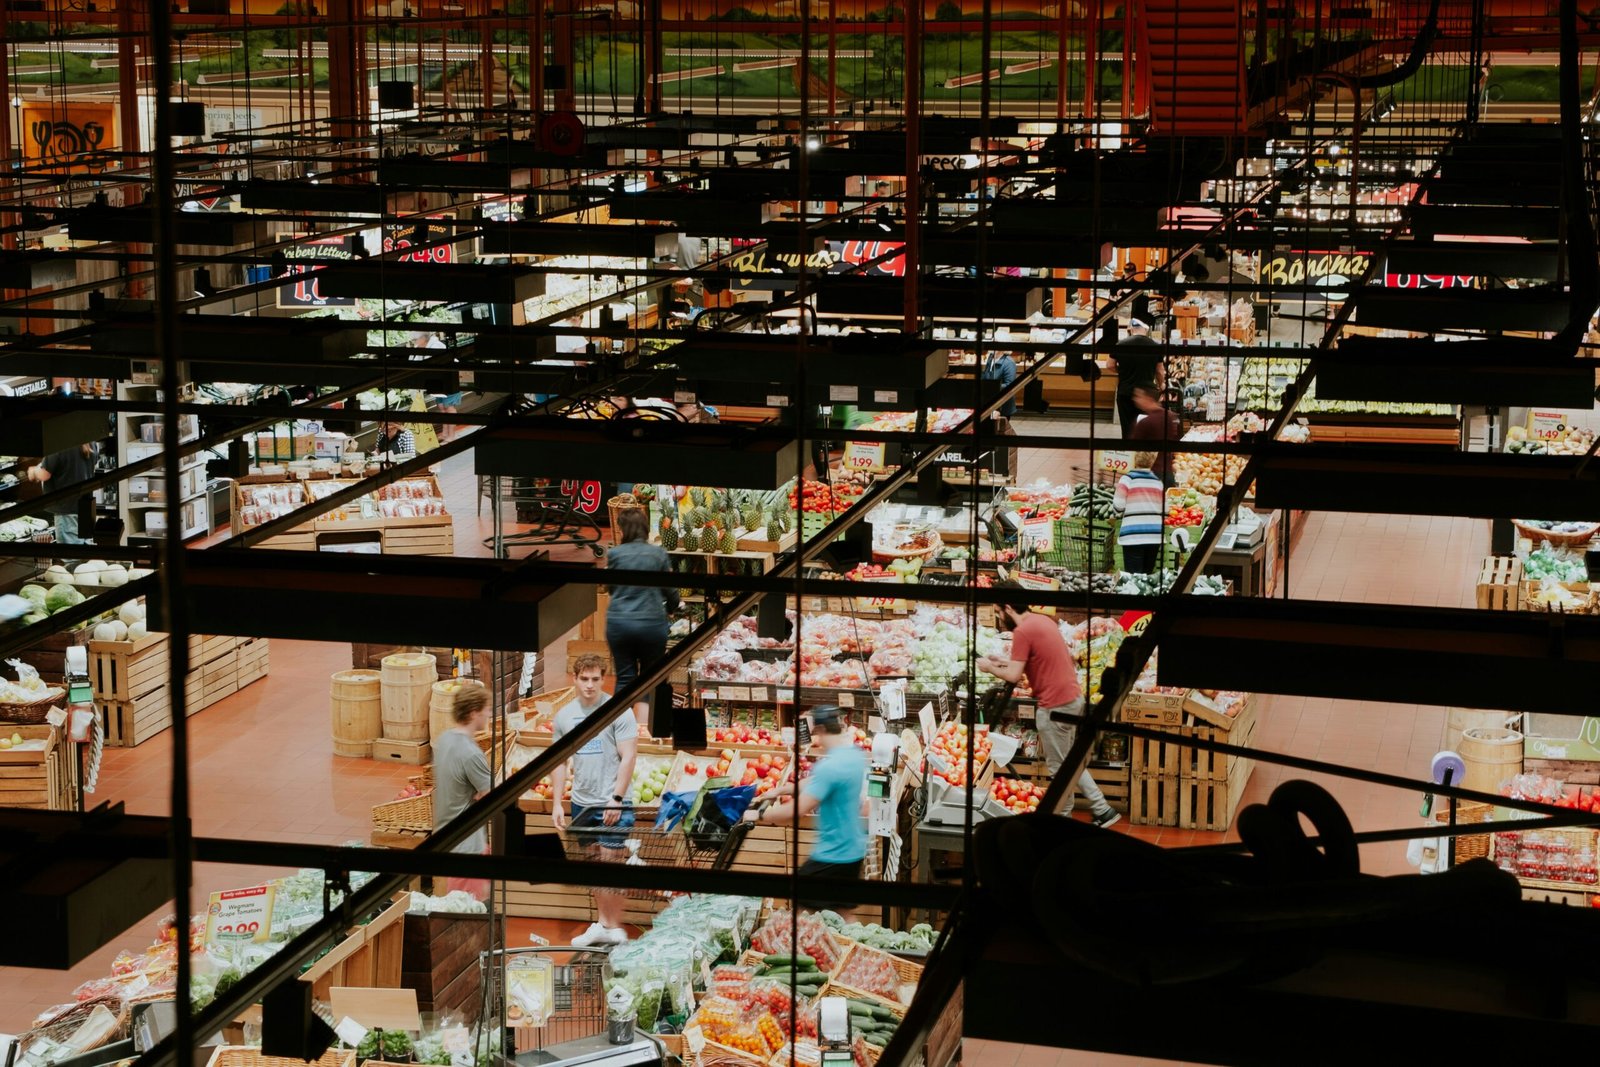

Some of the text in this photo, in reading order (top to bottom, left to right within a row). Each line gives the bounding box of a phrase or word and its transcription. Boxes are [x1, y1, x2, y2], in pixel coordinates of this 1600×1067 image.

[317, 244, 352, 260] Lettuce
[15, 379, 48, 397] VEGETABLES
[228, 902, 255, 910] Wegmans
[237, 907, 263, 915] Tomatoes
